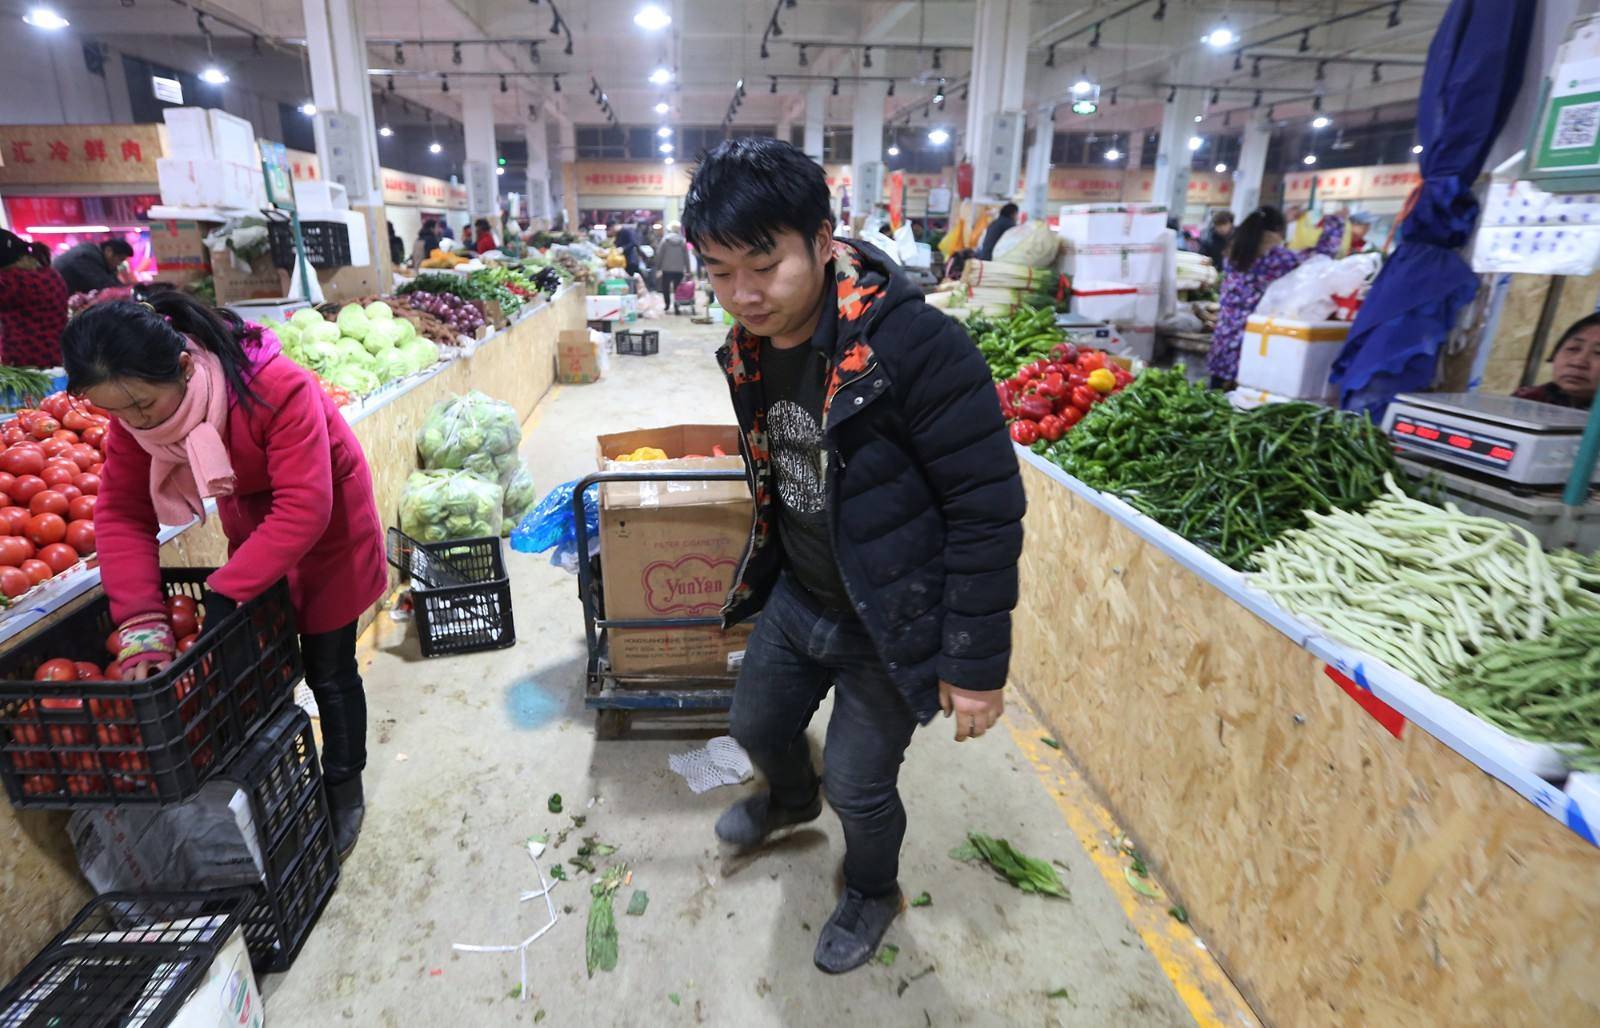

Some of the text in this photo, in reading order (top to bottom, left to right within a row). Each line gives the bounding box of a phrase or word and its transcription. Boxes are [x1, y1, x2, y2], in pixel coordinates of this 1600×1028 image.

[10, 138, 143, 164] 汇冷鲜肉
[663, 576, 722, 602] YunYan
